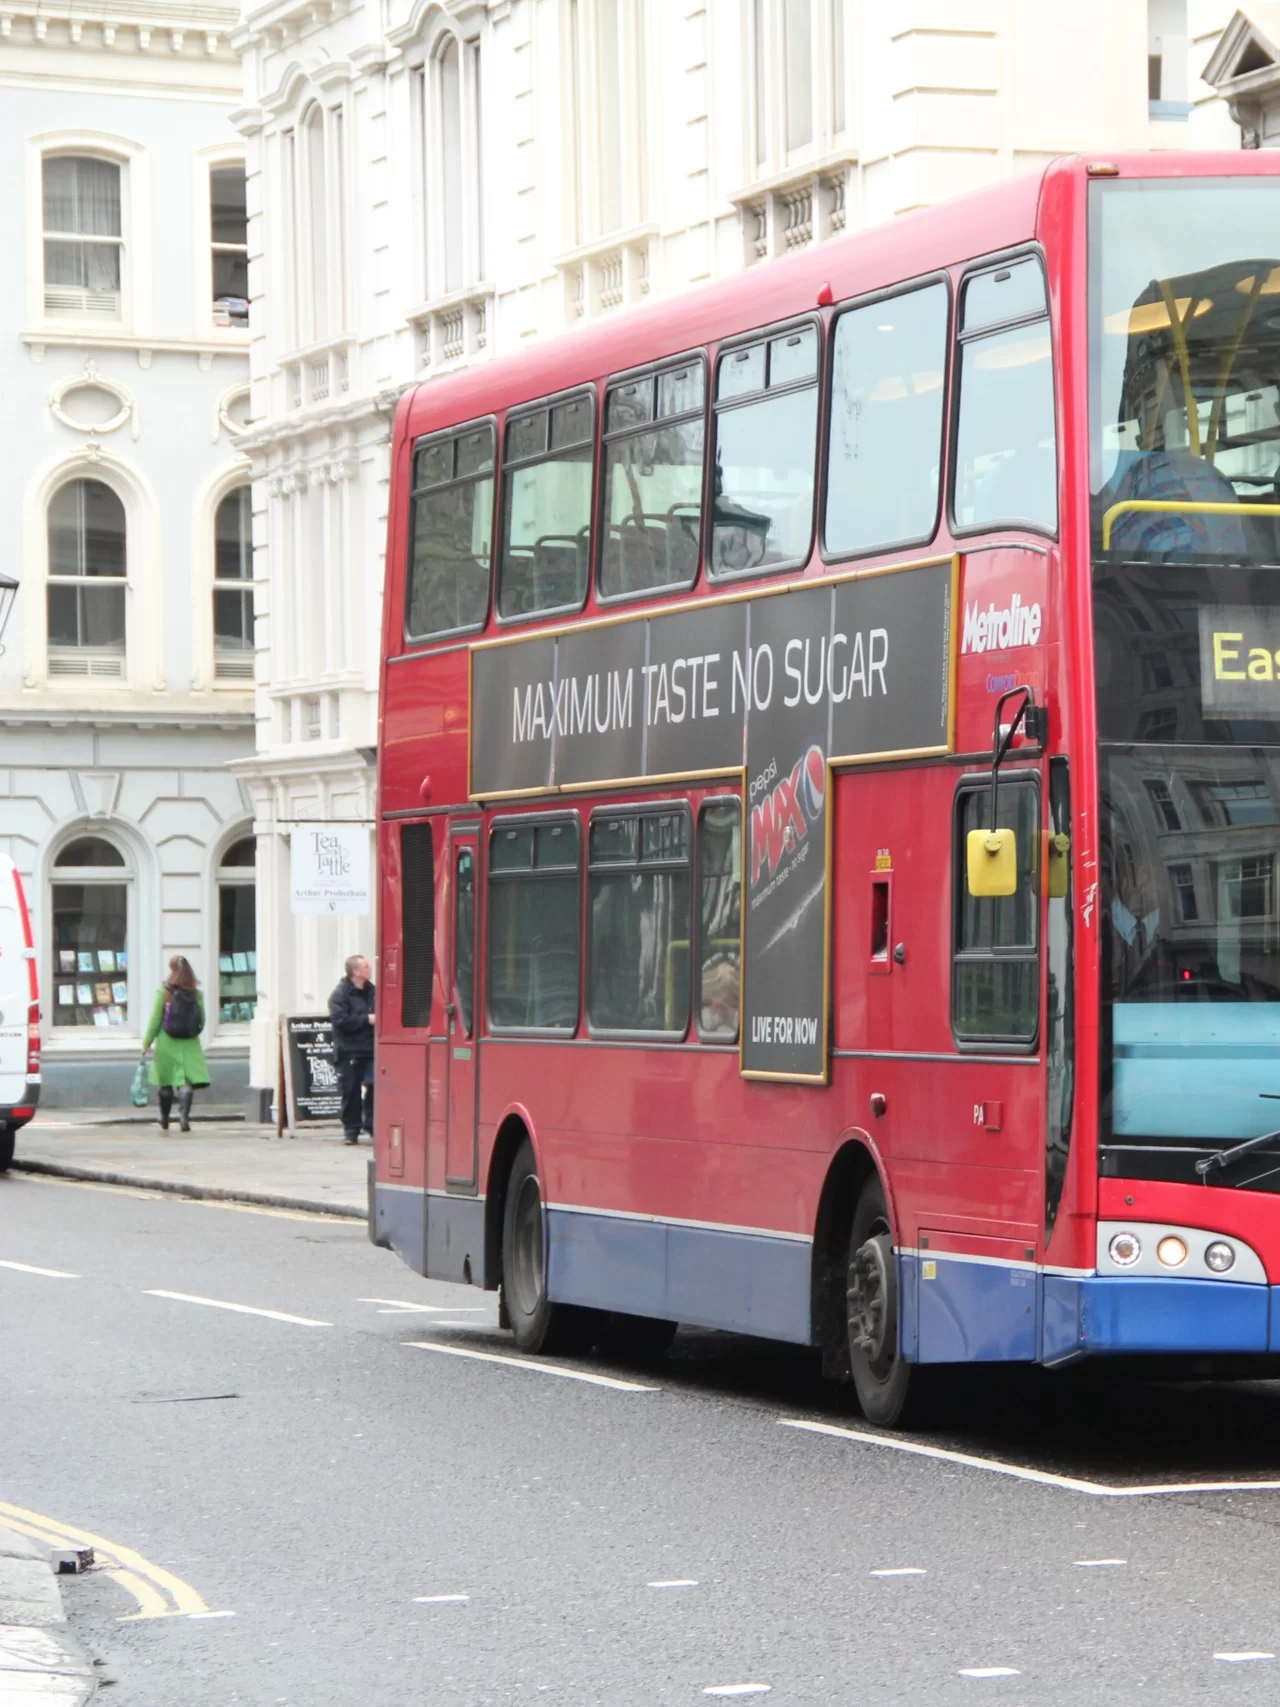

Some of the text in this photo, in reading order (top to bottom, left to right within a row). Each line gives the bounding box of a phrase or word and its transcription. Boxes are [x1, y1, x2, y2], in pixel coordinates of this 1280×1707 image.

[961, 593, 1042, 654] Metroline
[513, 668, 633, 743] MAXIMUM
[642, 653, 720, 726] TASTE
[731, 643, 773, 714] NO
[783, 628, 888, 707] SUGAR
[750, 757, 777, 803] pepsi
[751, 756, 808, 889] MAX
[309, 832, 338, 853] Tea
[314, 853, 350, 876] Tattle
[752, 1016, 818, 1045] LIVE FOR NOW
[973, 1104, 984, 1125] PA
